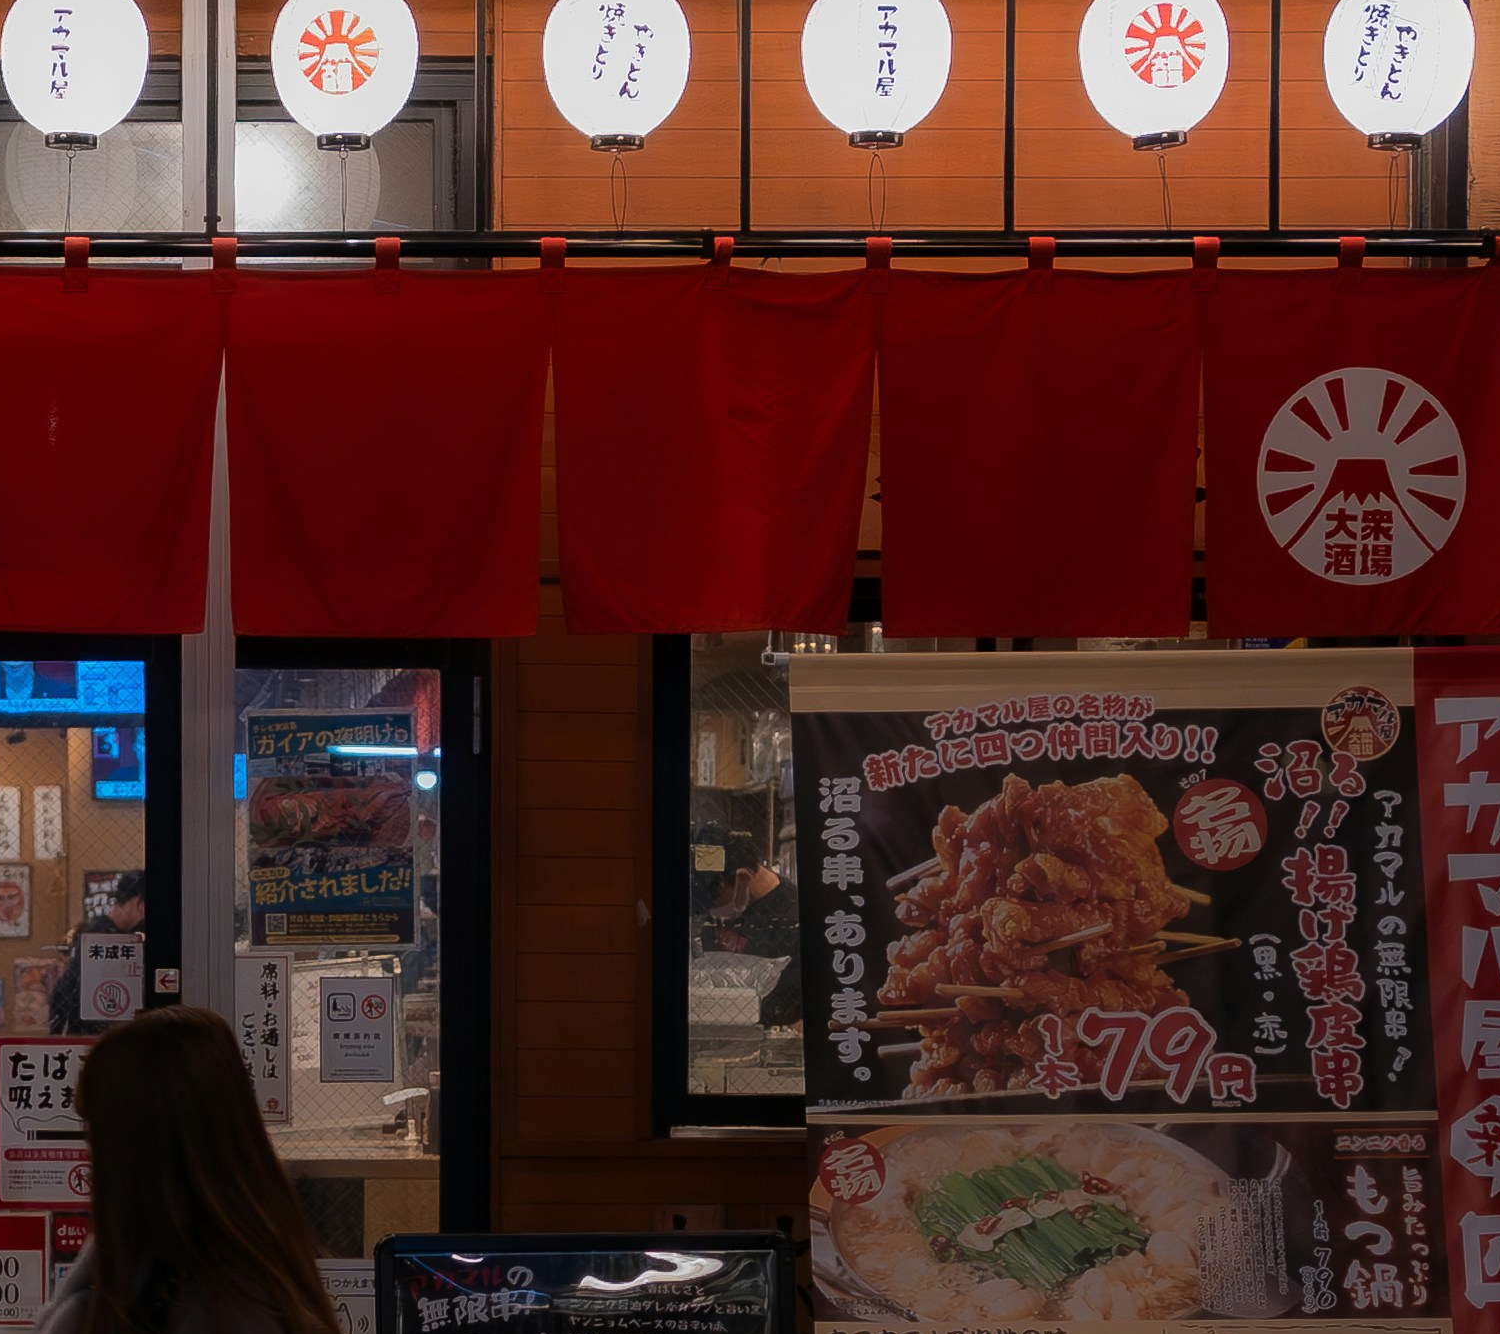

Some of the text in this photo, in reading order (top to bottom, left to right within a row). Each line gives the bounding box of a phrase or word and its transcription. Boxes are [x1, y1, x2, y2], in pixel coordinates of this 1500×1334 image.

[590, 0, 628, 83] 焼きとり
[616, 21, 657, 102] やきとん
[874, 4, 900, 98] アカマル屋
[1351, 0, 1392, 85] 焼きとり
[1378, 23, 1419, 103] やきとん
[1323, 542, 1394, 577] 酒場
[1324, 508, 1394, 541] 大衆
[926, 692, 1155, 740] アカマル屋の名物が
[863, 725, 1219, 793] 新たに四つ仲間入り!!
[1253, 739, 1367, 839] 沼る!!
[1179, 786, 1263, 865] 名物
[255, 868, 412, 905] 紹介されました!!
[87, 944, 137, 962] 未成年
[818, 775, 873, 1082] 沼る串、あります。
[1281, 843, 1367, 1109] 揚げ鶏皮串
[259, 961, 280, 1080] 席料・お通しは
[8, 1050, 88, 1082] たば
[823, 1143, 882, 1200] 名物
[1343, 1164, 1404, 1310] もつ鍋
[1401, 1165, 1430, 1306] 旨みたっぷり
[417, 1287, 537, 1333] 無限串!
[1312, 1248, 1337, 1310] 790
